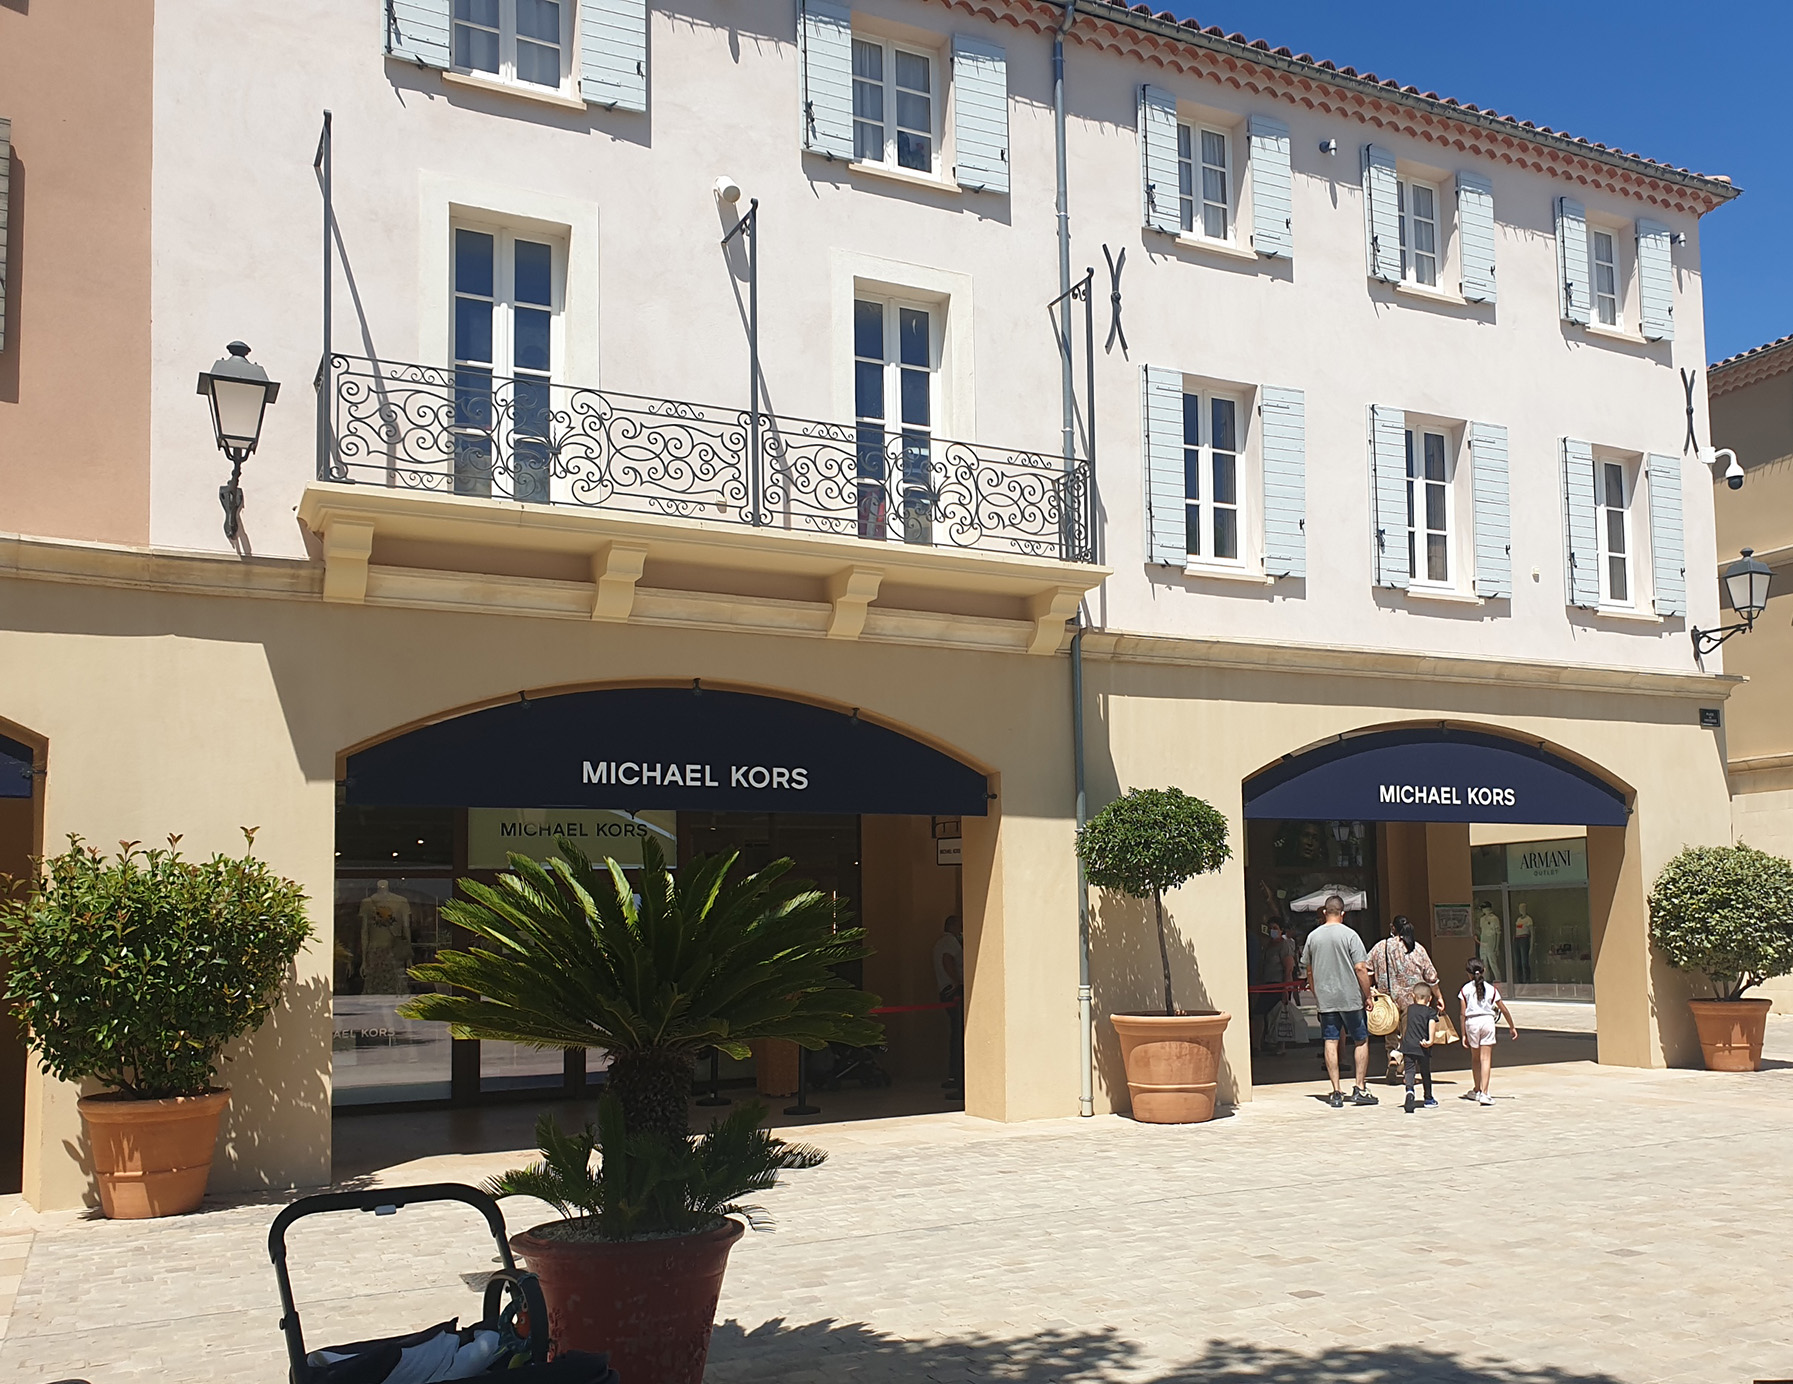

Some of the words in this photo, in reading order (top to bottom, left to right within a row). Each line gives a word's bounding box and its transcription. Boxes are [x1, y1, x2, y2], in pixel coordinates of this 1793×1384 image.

[582, 760, 719, 787] MICHAEL
[731, 765, 809, 790] KORS
[1379, 785, 1462, 805] MICHAEL
[1467, 787, 1516, 806] KORS
[500, 822, 588, 837] MICHAEL
[596, 823, 648, 837] KORS
[1520, 849, 1571, 870] ARMANI
[361, 1027, 396, 1038] KORS
